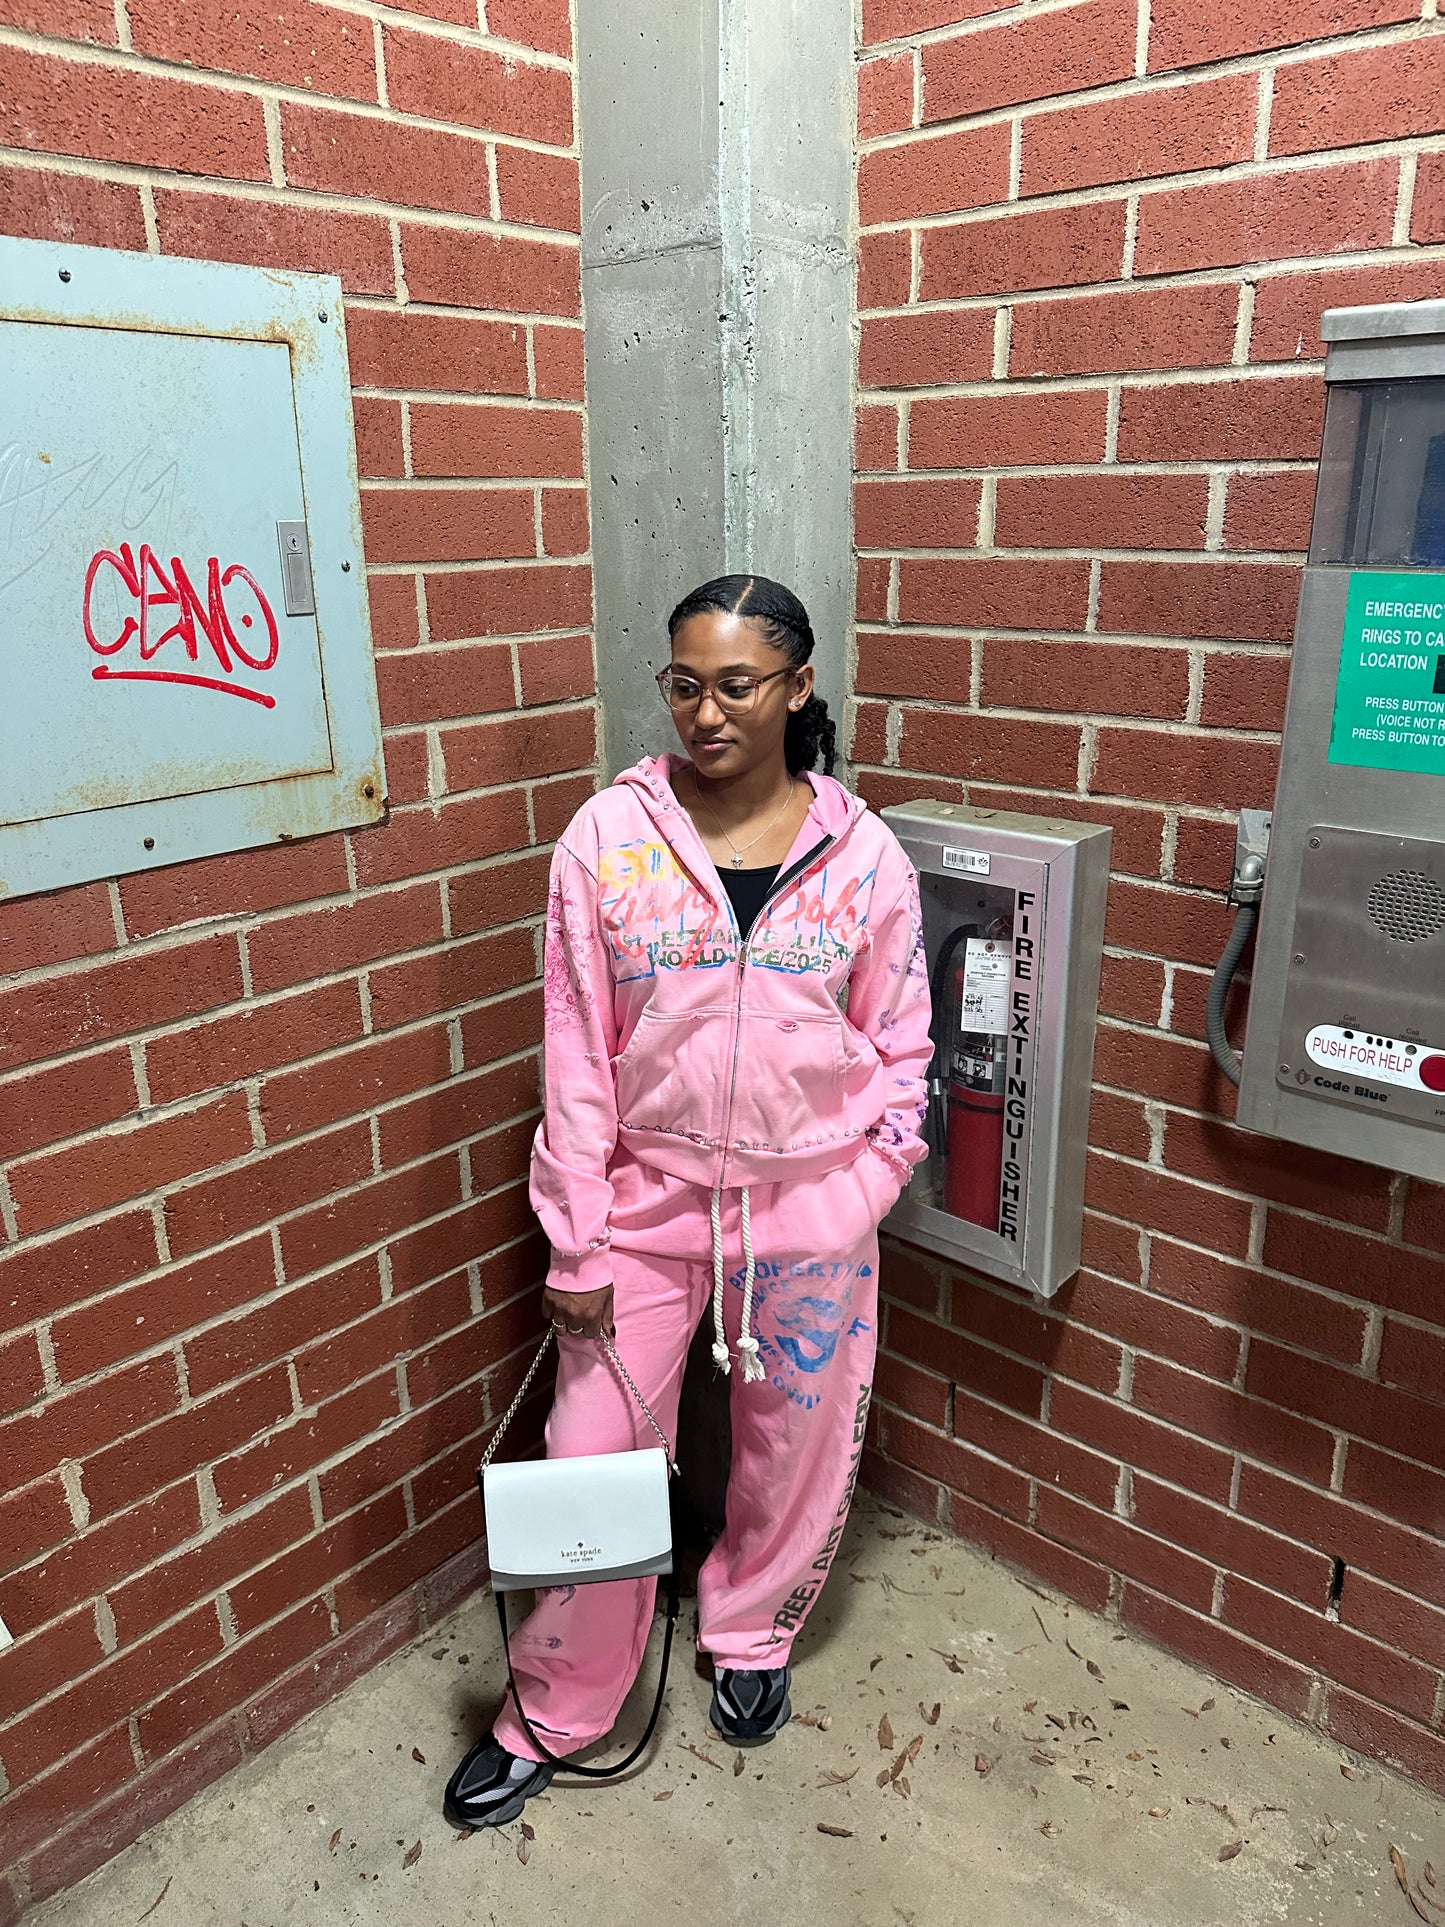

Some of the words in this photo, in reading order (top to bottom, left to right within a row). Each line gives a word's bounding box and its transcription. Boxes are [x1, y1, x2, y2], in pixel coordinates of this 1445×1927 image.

[1365, 601, 1445, 619] EMERGENC
[1361, 629, 1401, 645] RINGS
[1404, 630, 1422, 646] TO
[1425, 631, 1445, 647] CA
[1359, 652, 1428, 670] LOCATION
[1365, 696, 1399, 710] PRESS
[1402, 699, 1445, 714] BUTTON
[1376, 713, 1412, 728] (VOICE
[1413, 717, 1436, 729] NOT
[1352, 728, 1386, 742] PRESS
[1388, 731, 1430, 746] BUTTON
[1432, 735, 1445, 747] TO
[1014, 890, 1036, 981] FIRE
[1313, 1036, 1347, 1059] PUSH
[1350, 1046, 1376, 1066] FOR
[1378, 1052, 1413, 1073] HELP
[1314, 1076, 1350, 1093] Code
[1354, 1085, 1388, 1102] Blue
[1000, 992, 1031, 1243] EXTINGUISHER
[580, 1547, 601, 1557] spade
[764, 1576, 821, 1646] TREET
